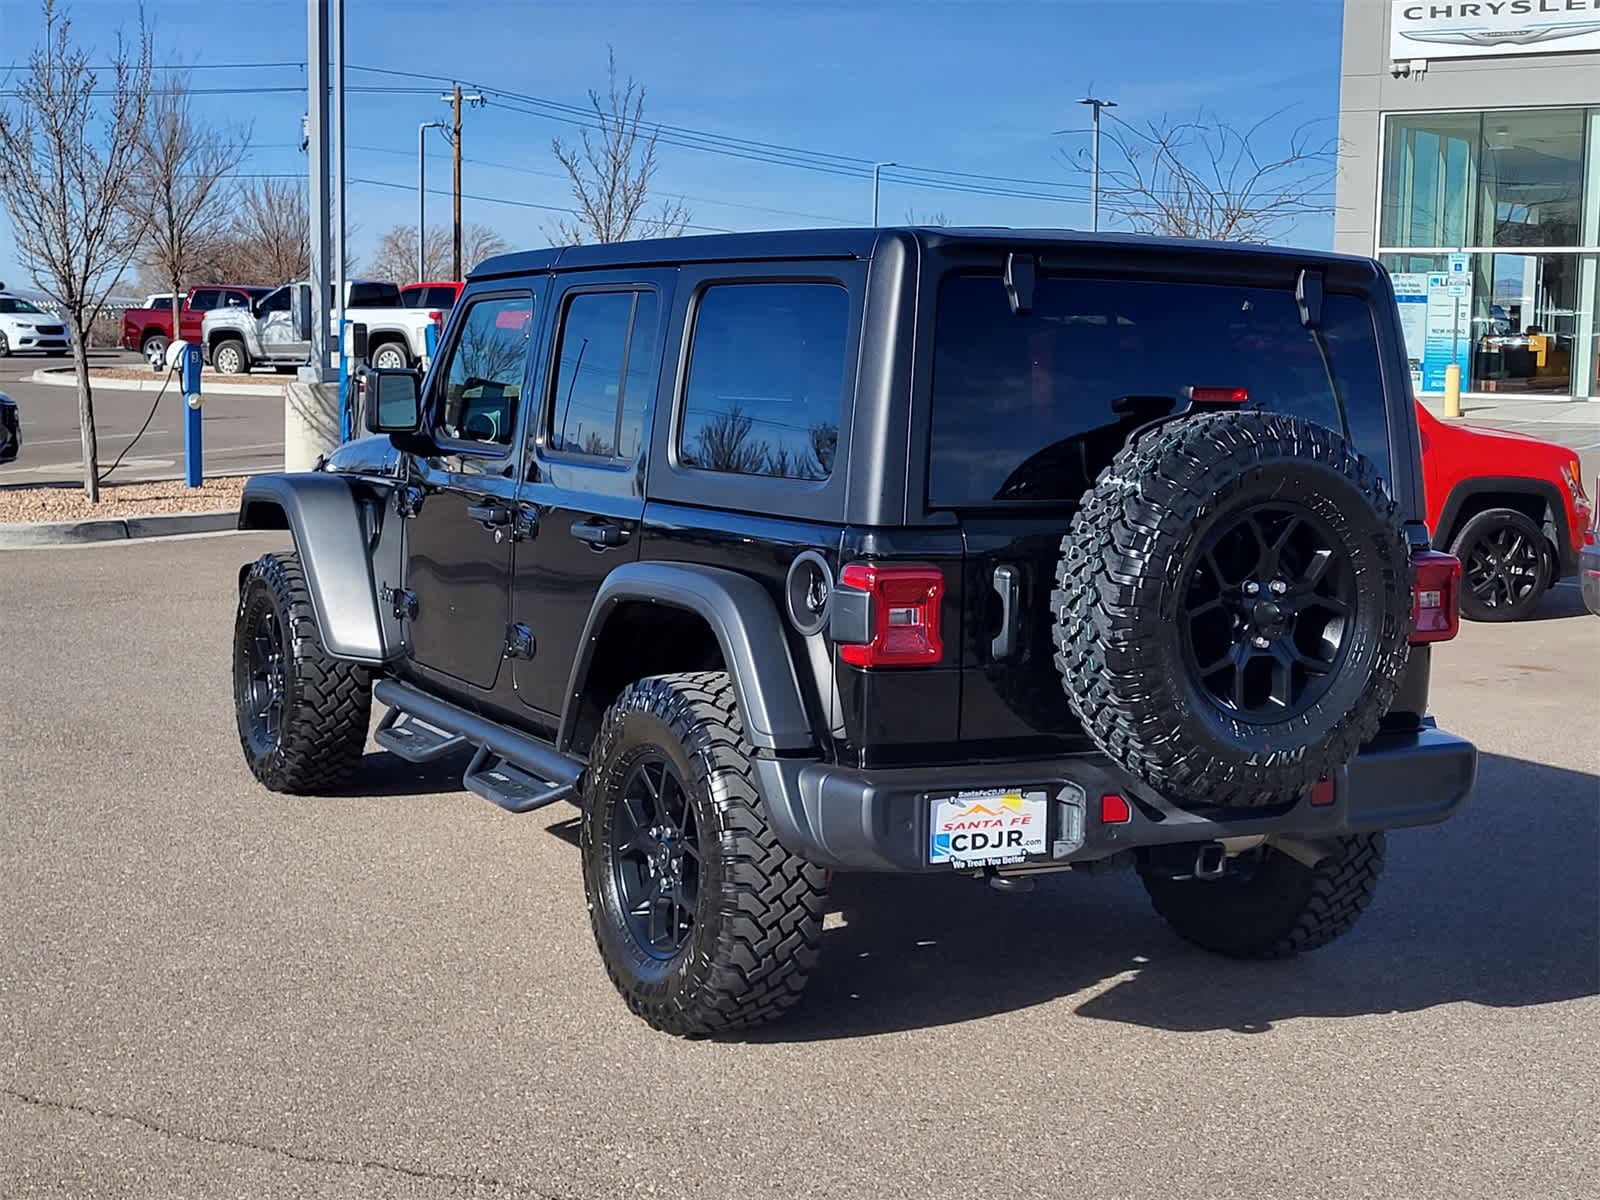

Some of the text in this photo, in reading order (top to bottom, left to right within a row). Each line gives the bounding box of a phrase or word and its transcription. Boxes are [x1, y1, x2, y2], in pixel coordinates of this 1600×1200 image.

[1403, 0, 1600, 20] CHRYSLE
[943, 816, 1032, 831] SANTA FE
[953, 855, 1026, 869] We Treat You Better
